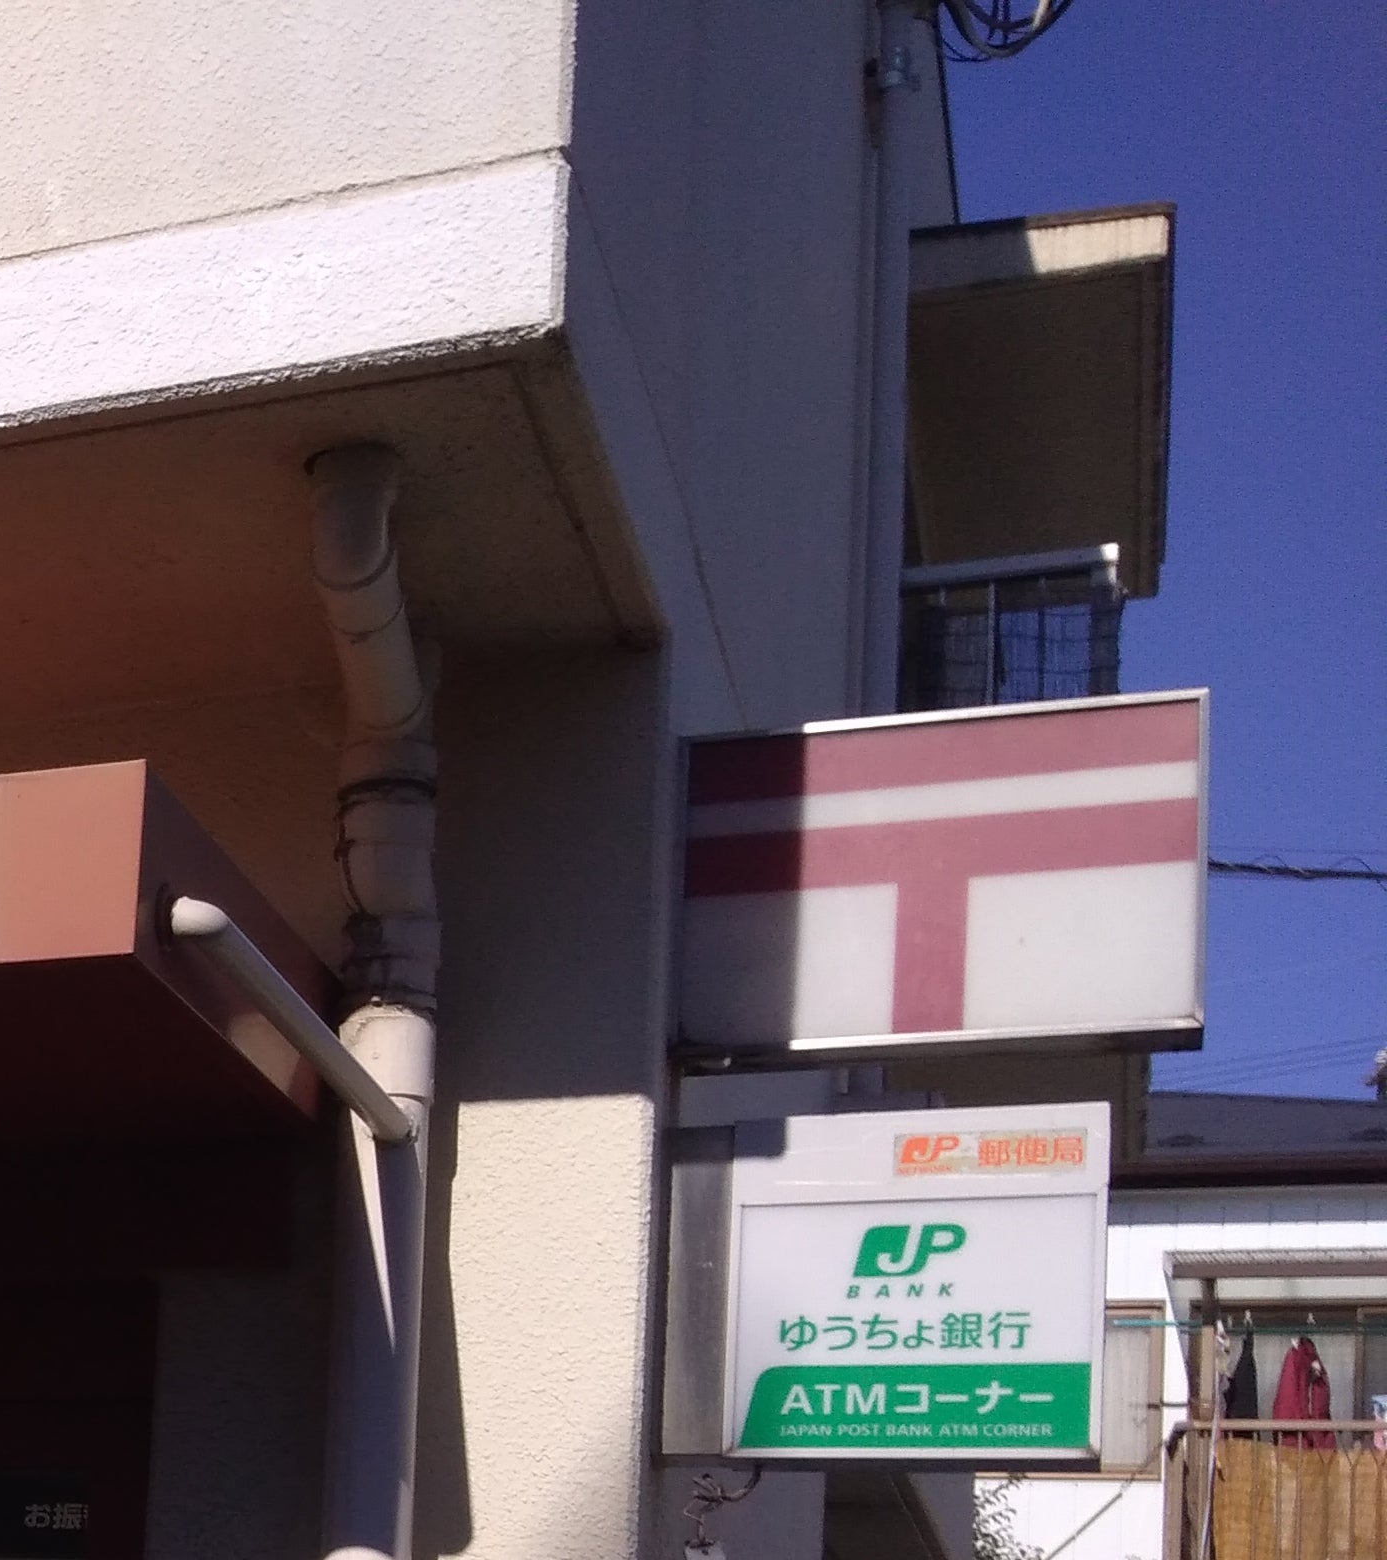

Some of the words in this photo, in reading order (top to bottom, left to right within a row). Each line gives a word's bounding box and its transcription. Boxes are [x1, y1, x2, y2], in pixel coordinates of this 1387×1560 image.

[899, 1135, 960, 1164] JP
[978, 1136, 1084, 1167] 郵便局
[853, 1223, 967, 1278] JP
[846, 1282, 956, 1299] BANK
[779, 1310, 1033, 1352] ゆうちょ銀行
[780, 1380, 1055, 1416] ATMコーナー
[780, 1425, 832, 1438] JAPAN
[837, 1425, 882, 1438] POST
[885, 1424, 933, 1438] BANK
[938, 1424, 979, 1438] ATM
[983, 1424, 1053, 1438] CORNER
[23, 1502, 88, 1530] お振
